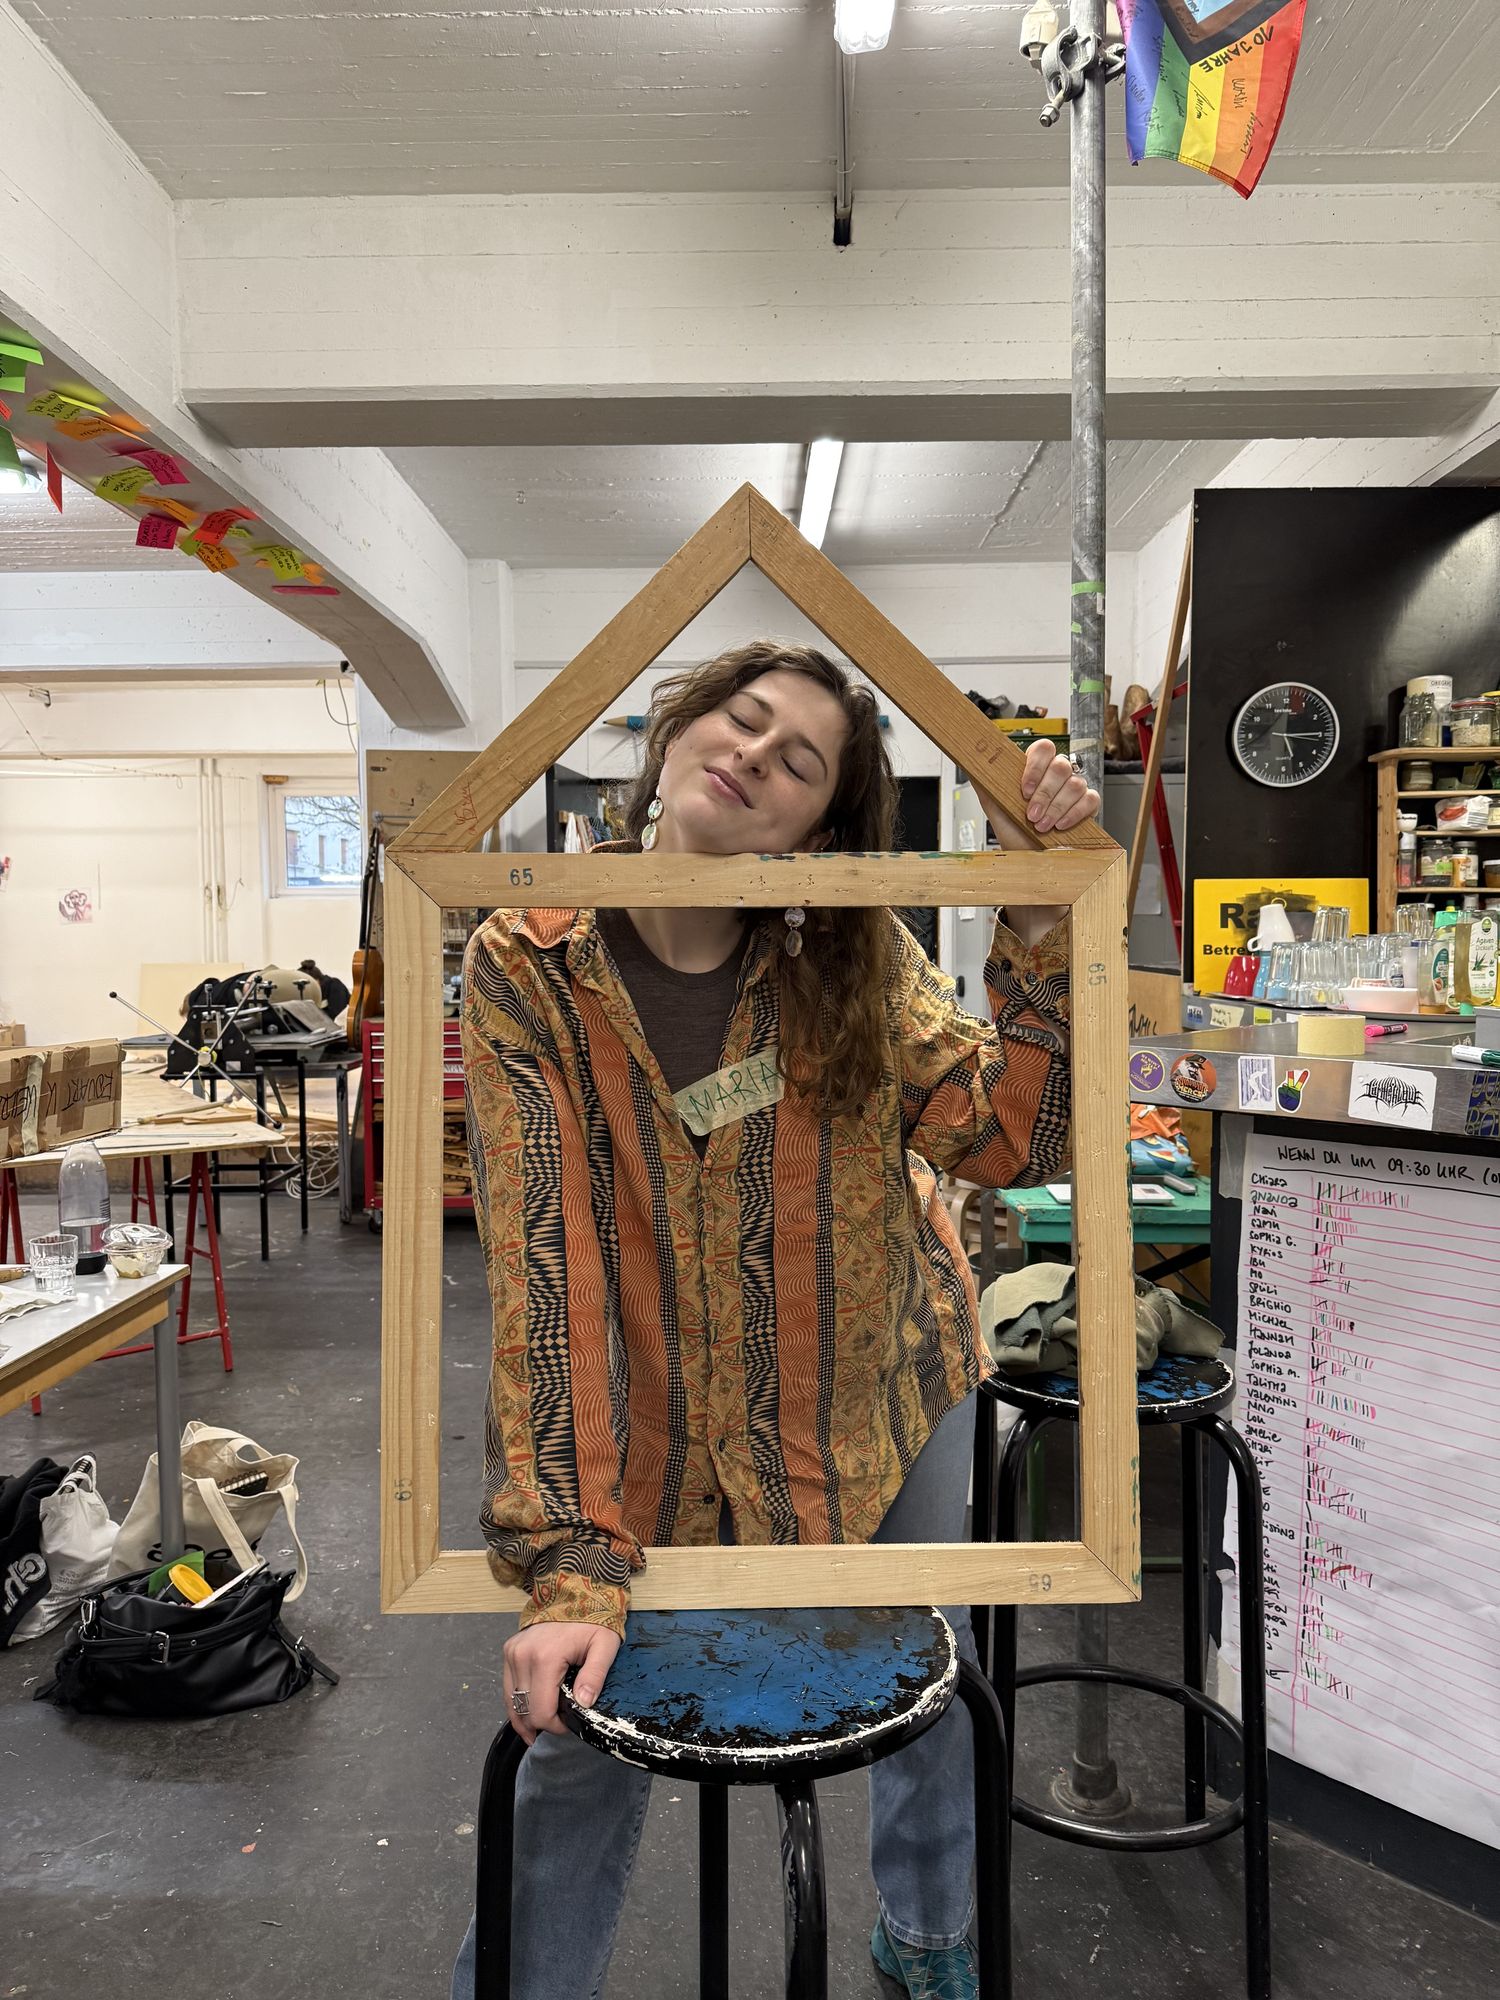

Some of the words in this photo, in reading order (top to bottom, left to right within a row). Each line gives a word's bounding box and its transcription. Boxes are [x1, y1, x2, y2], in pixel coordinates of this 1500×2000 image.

[1198, 39, 1253, 74] JAHRE
[509, 867, 534, 886] 65
[1088, 963, 1107, 986] 65
[687, 1060, 785, 1124] MARIA
[1278, 1145, 1315, 1162] WENN
[1323, 1150, 1341, 1164] DU
[1351, 1153, 1376, 1170] UM
[1387, 1157, 1431, 1177] 09:30
[1437, 1161, 1475, 1181] UHR
